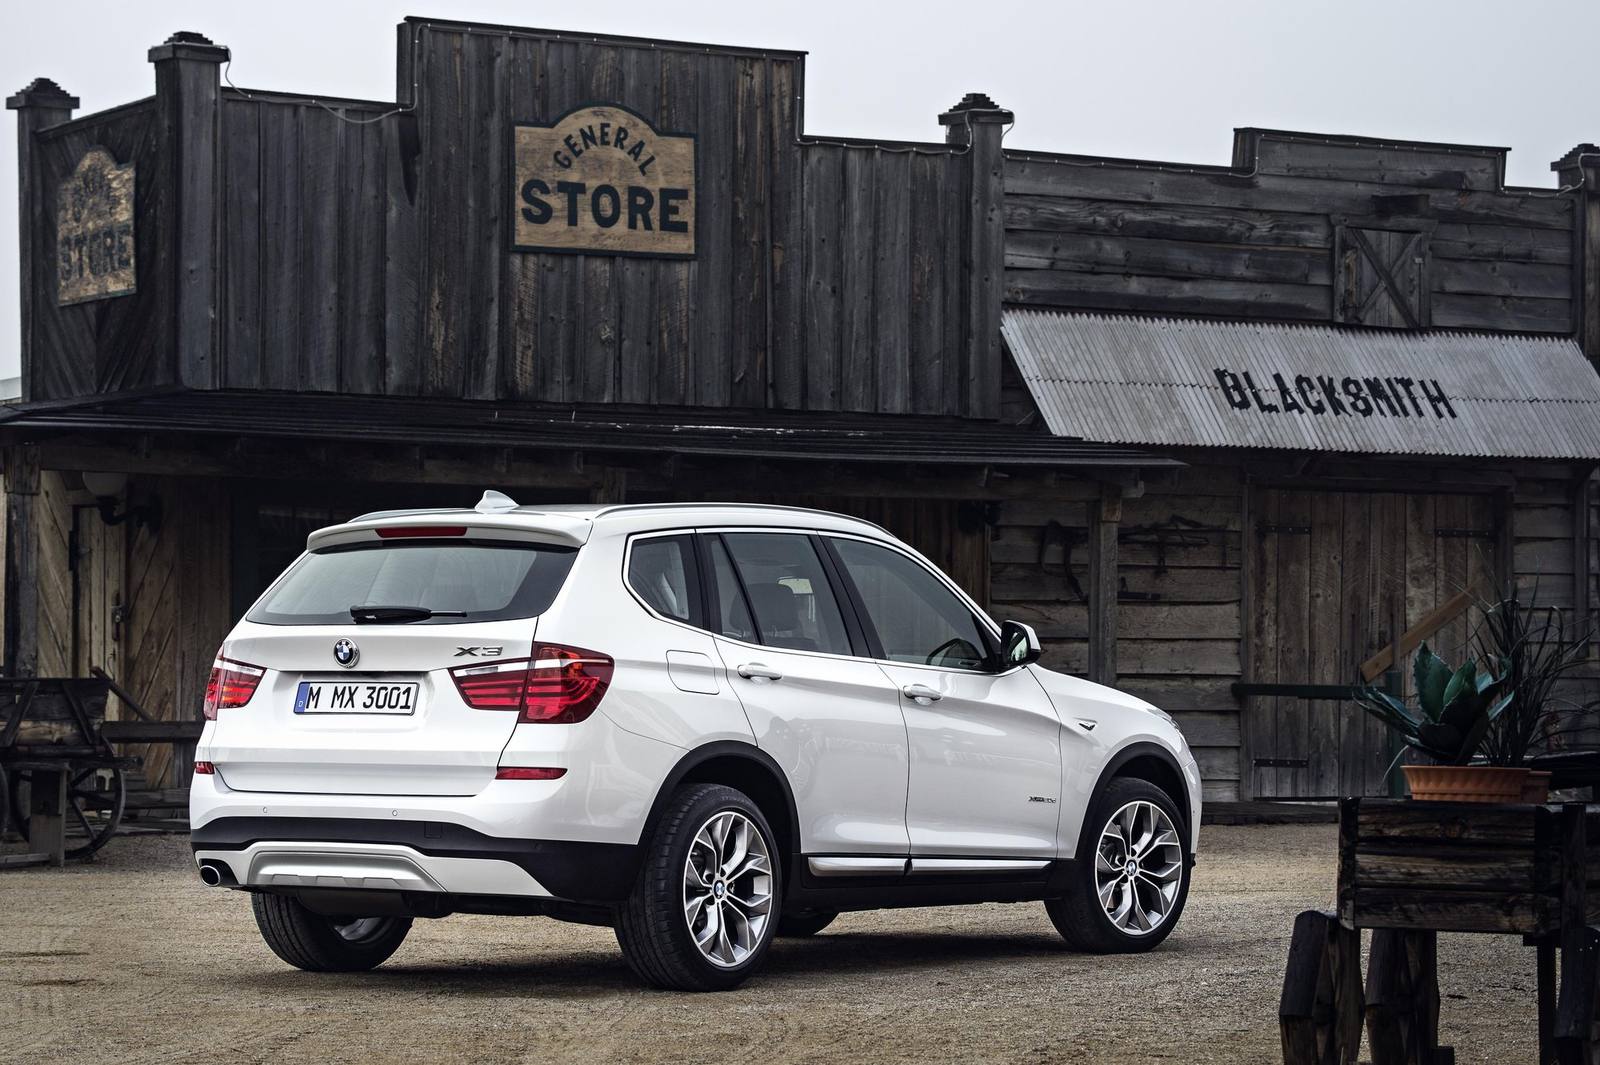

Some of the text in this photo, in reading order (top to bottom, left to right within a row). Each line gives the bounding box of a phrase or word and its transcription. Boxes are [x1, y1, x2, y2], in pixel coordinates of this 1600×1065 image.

[553, 123, 656, 176] GENERAL
[521, 179, 689, 233] STORE
[1213, 367, 1458, 419] BLACKSMITH
[453, 646, 504, 657] X3
[305, 686, 412, 710] M MX 3001
